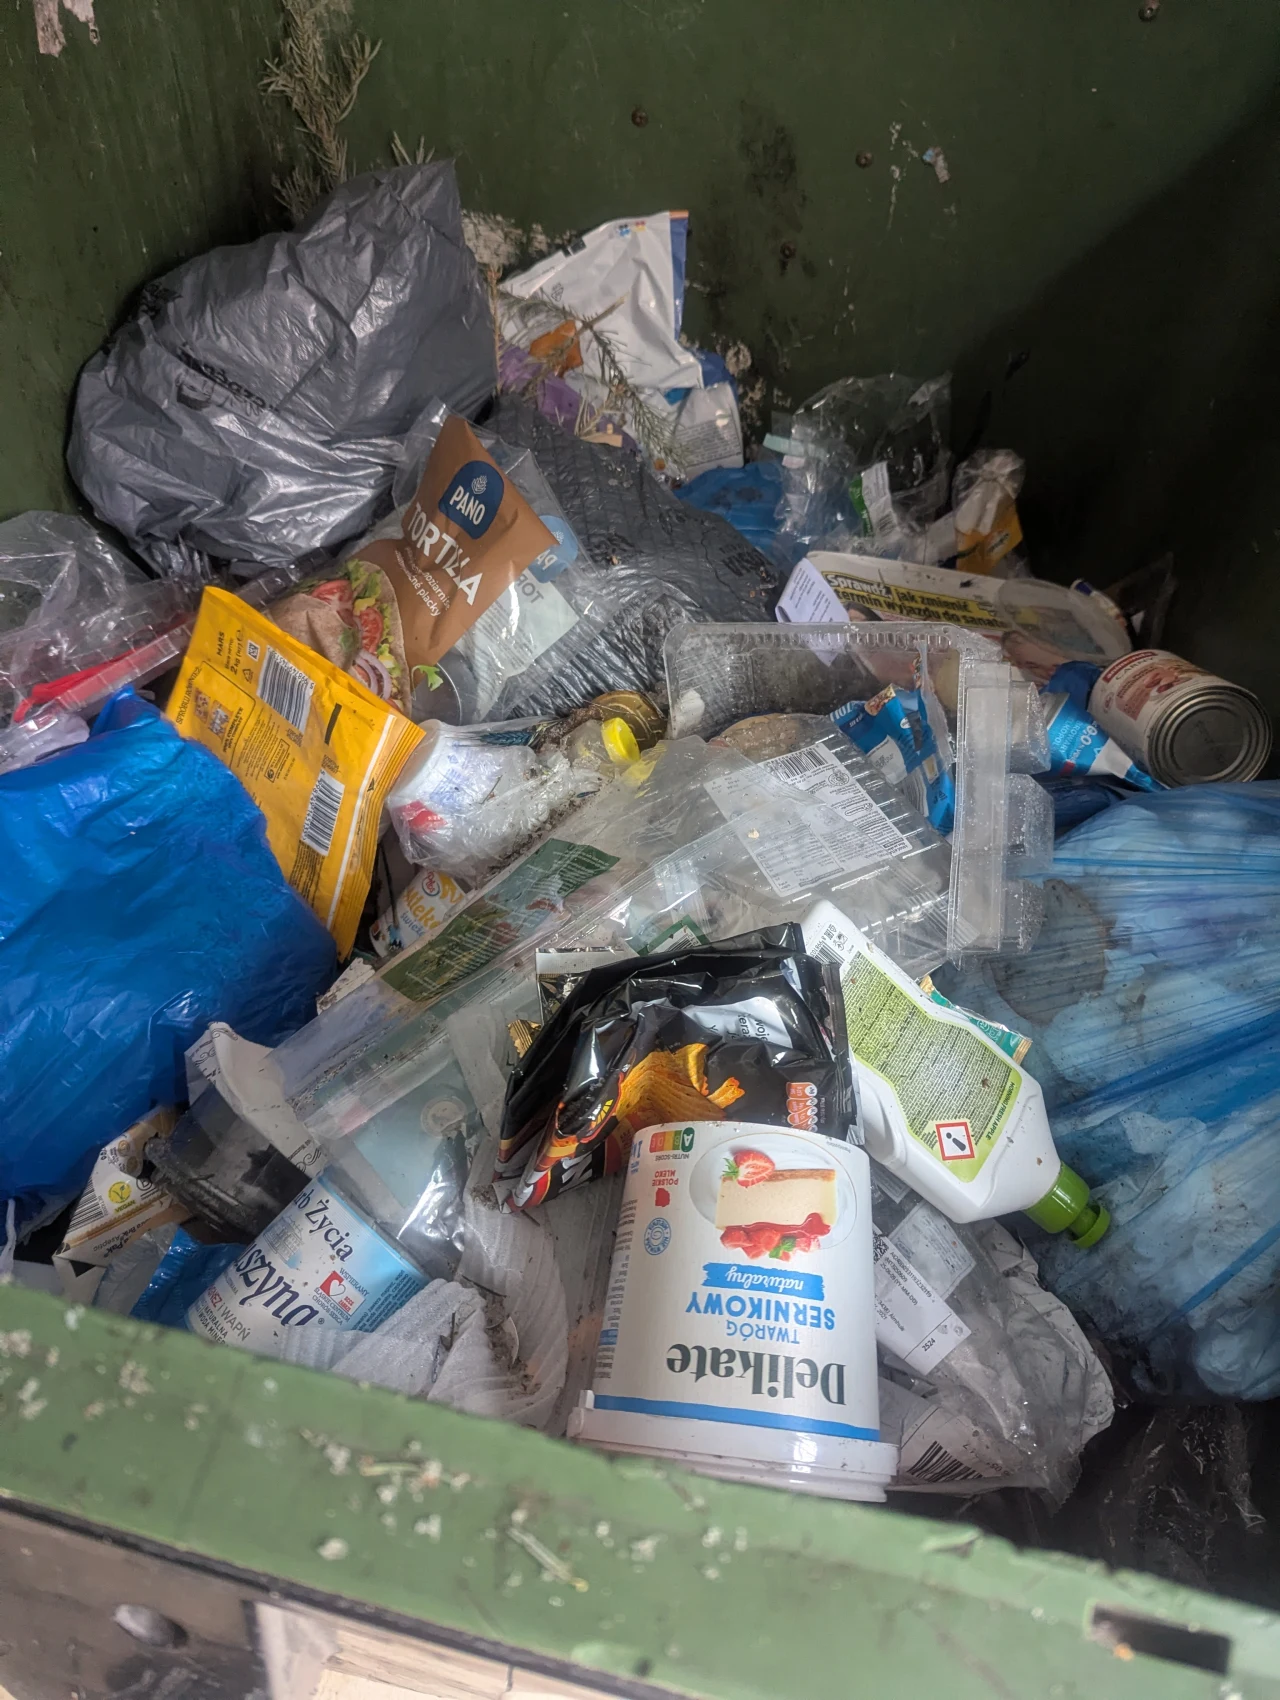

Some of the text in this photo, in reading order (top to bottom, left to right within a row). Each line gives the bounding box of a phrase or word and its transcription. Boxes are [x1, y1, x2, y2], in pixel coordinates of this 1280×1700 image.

[450, 485, 486, 526] PANO
[417, 587, 441, 615] placky
[215, 632, 226, 655] MARS
[996, 1104, 1007, 1121] FRESH
[683, 1132, 693, 1149] A
[986, 1121, 998, 1140] APPLE
[656, 1153, 690, 1162] NUTRI-SCORE
[652, 1178, 679, 1188] POLSKIE
[654, 1169, 677, 1178] MLEKO
[115, 1200, 136, 1212] VEGAN
[304, 1198, 354, 1262] Życia
[231, 1243, 320, 1327] uszyna
[338, 1267, 370, 1298] WSPIERAMY
[725, 1266, 804, 1290] naturalny
[198, 1312, 210, 1328] WODA
[204, 1306, 229, 1338] NATURALNA
[685, 1291, 836, 1331] SERNIKOWY
[220, 1306, 253, 1341] WAPŃ
[726, 1321, 800, 1344] TWARÓG
[922, 1337, 936, 1352] 2524
[667, 1343, 846, 1405] Delikate
